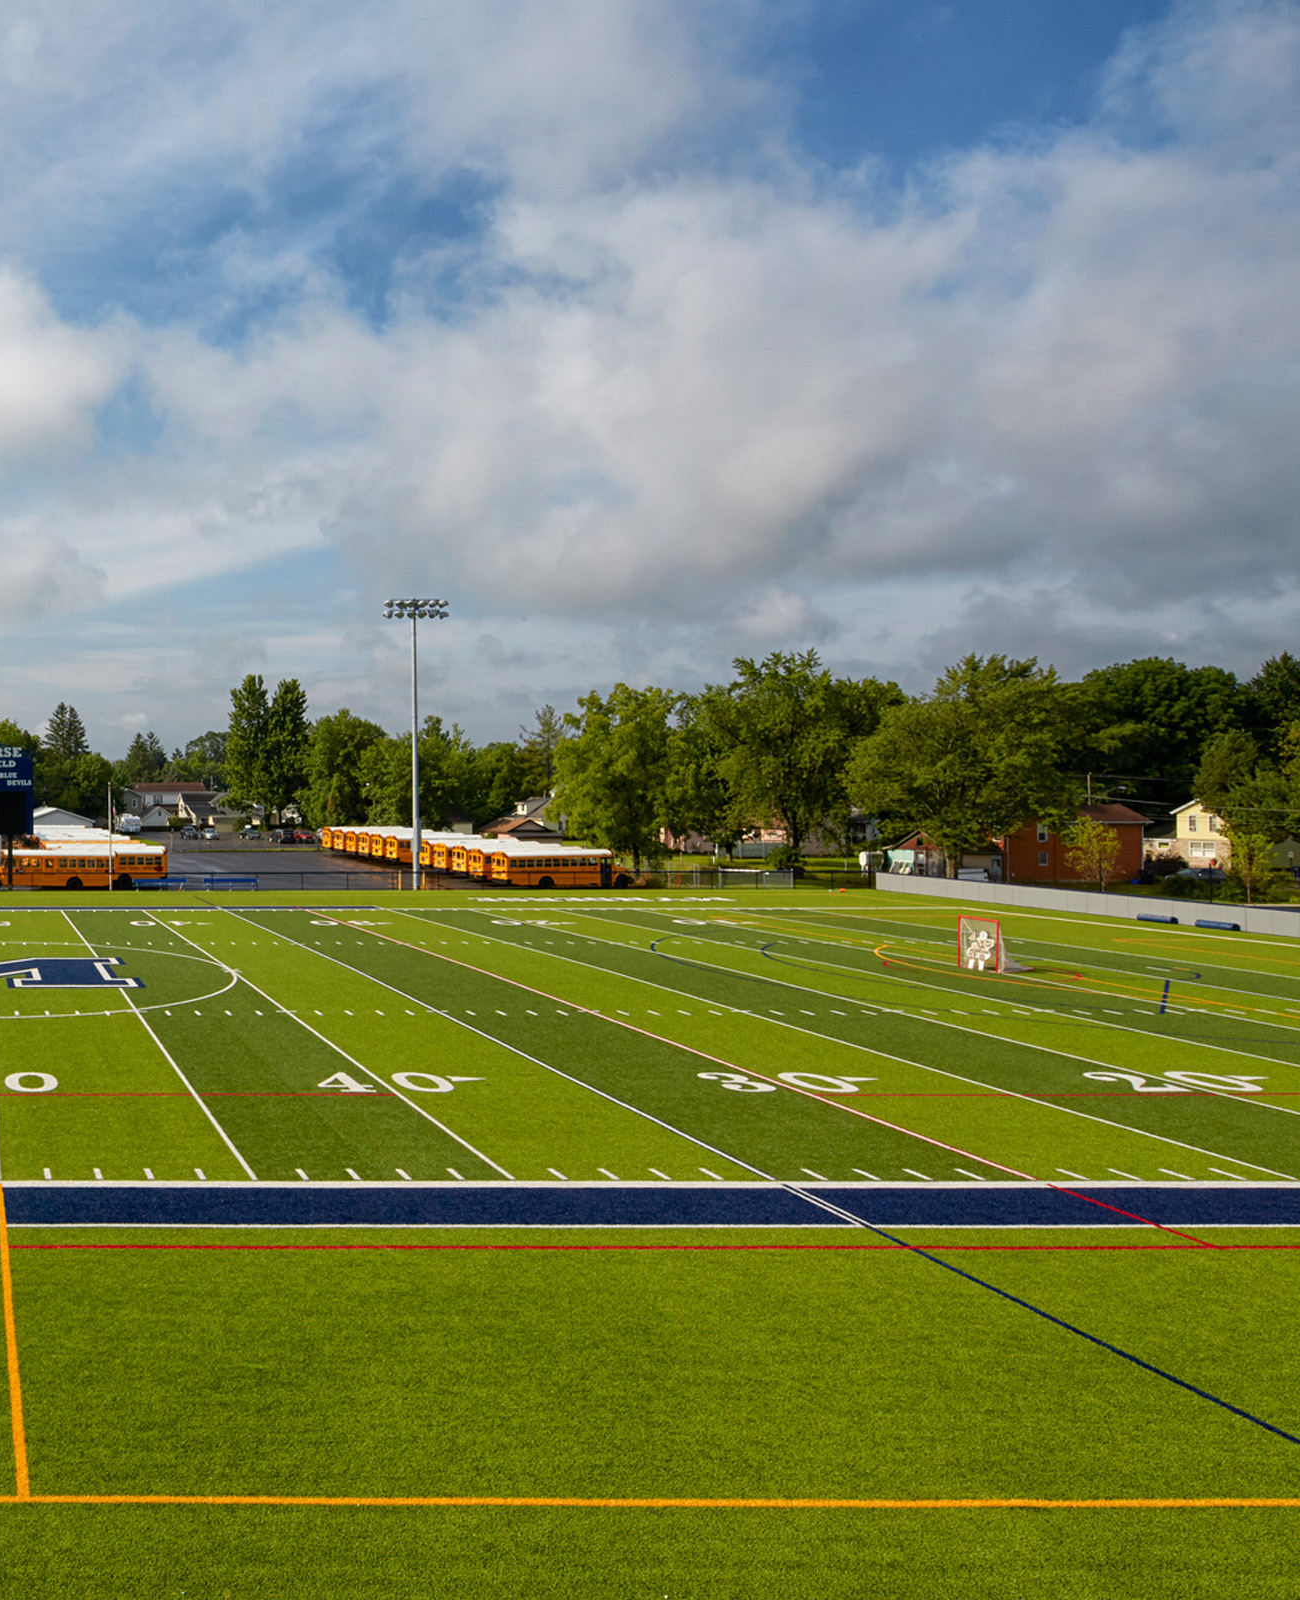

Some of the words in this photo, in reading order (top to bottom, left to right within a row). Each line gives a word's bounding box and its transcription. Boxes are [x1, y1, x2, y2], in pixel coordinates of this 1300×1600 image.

[317, 1071, 455, 1093] 40
[697, 1071, 860, 1093] 30
[1082, 1070, 1264, 1093] 20
